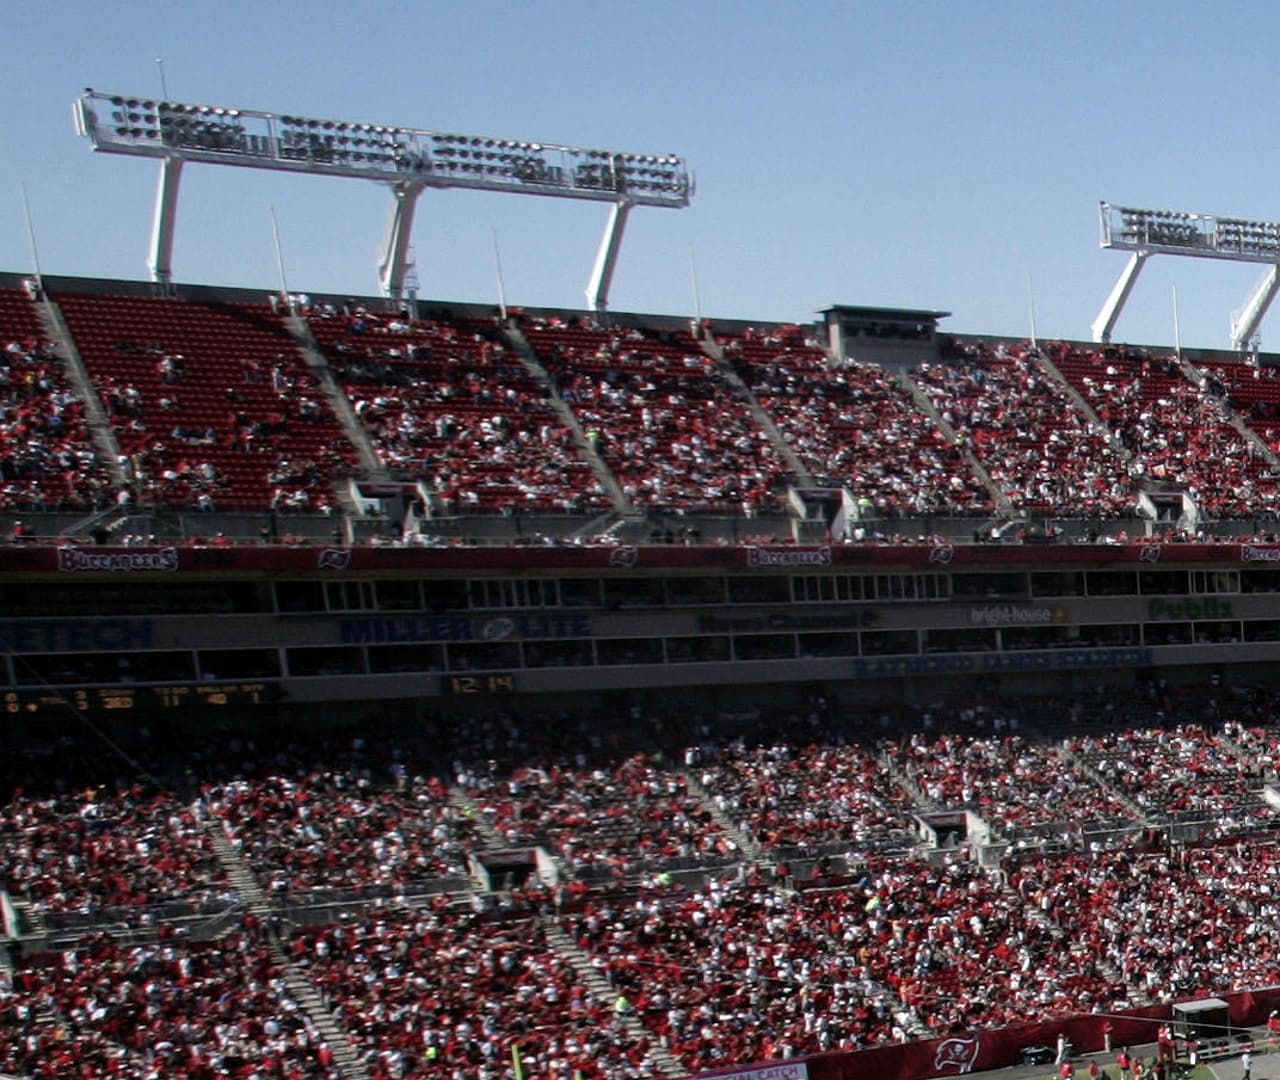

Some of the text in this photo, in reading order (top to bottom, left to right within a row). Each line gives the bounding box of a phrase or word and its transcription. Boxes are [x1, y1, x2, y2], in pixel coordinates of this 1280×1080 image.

[339, 614, 593, 643] MILLER LITE
[757, 1066, 798, 1080] CATCH
